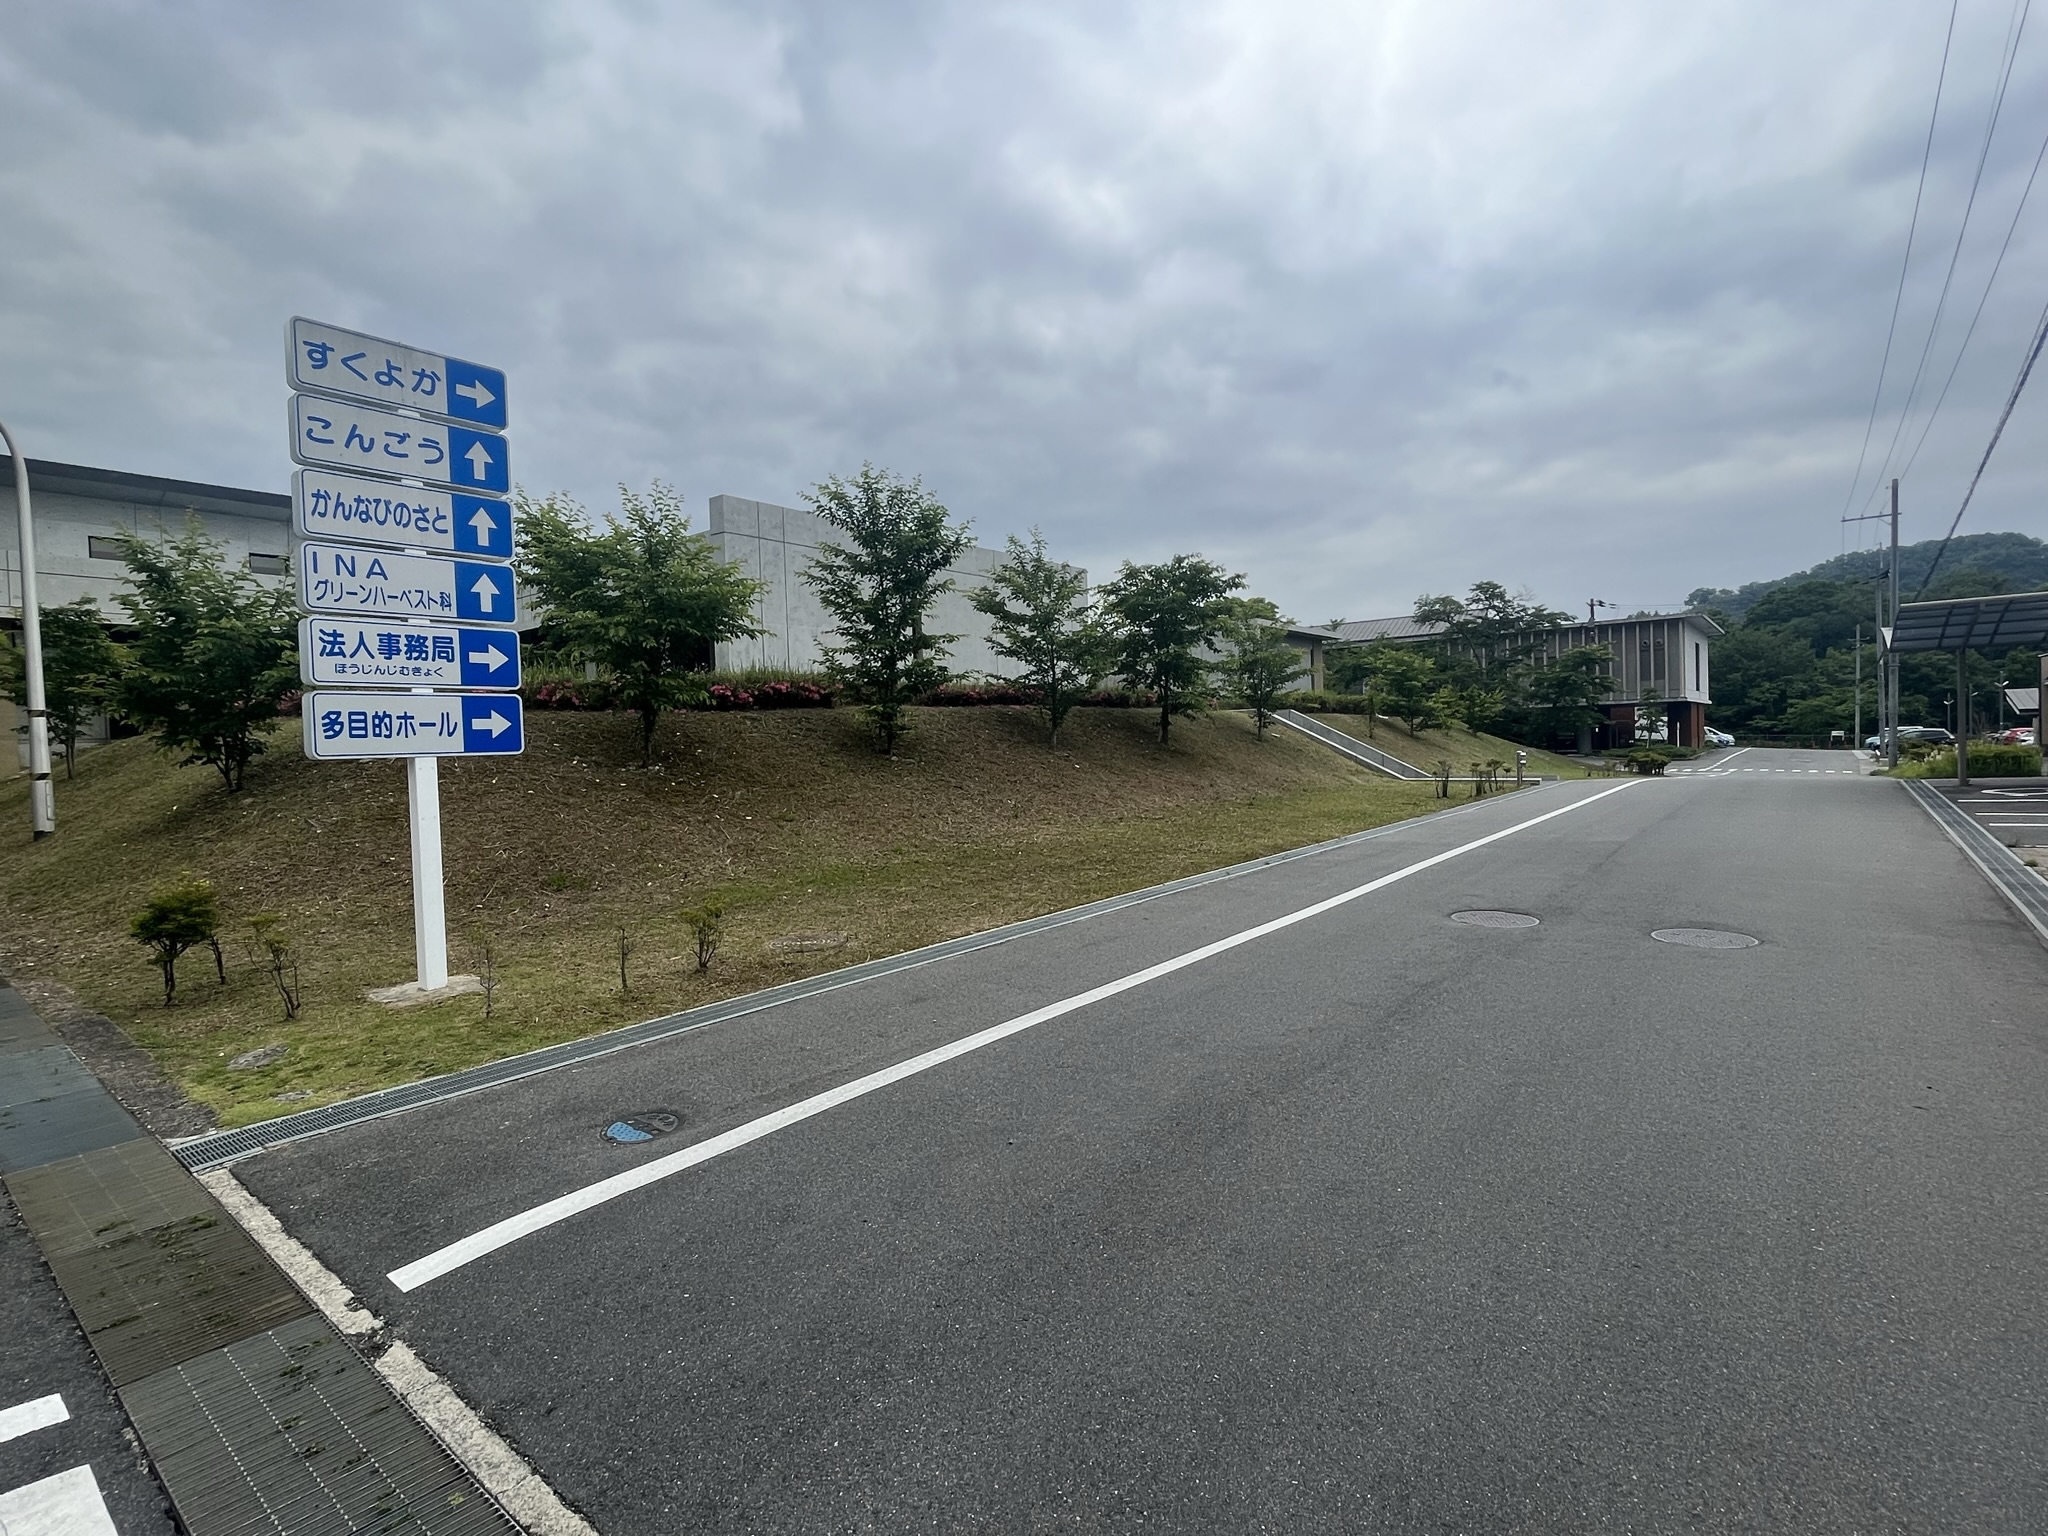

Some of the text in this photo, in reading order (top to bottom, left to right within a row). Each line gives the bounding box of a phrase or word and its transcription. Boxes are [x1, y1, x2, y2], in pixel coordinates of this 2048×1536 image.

[303, 340, 441, 396] すくよか
[306, 415, 444, 464] こんごう
[311, 488, 449, 534] かんなびのさと
[314, 579, 452, 612] グリーンハーベスト科
[318, 629, 456, 663] 法人事務局
[321, 710, 458, 740] 多目的ホール
